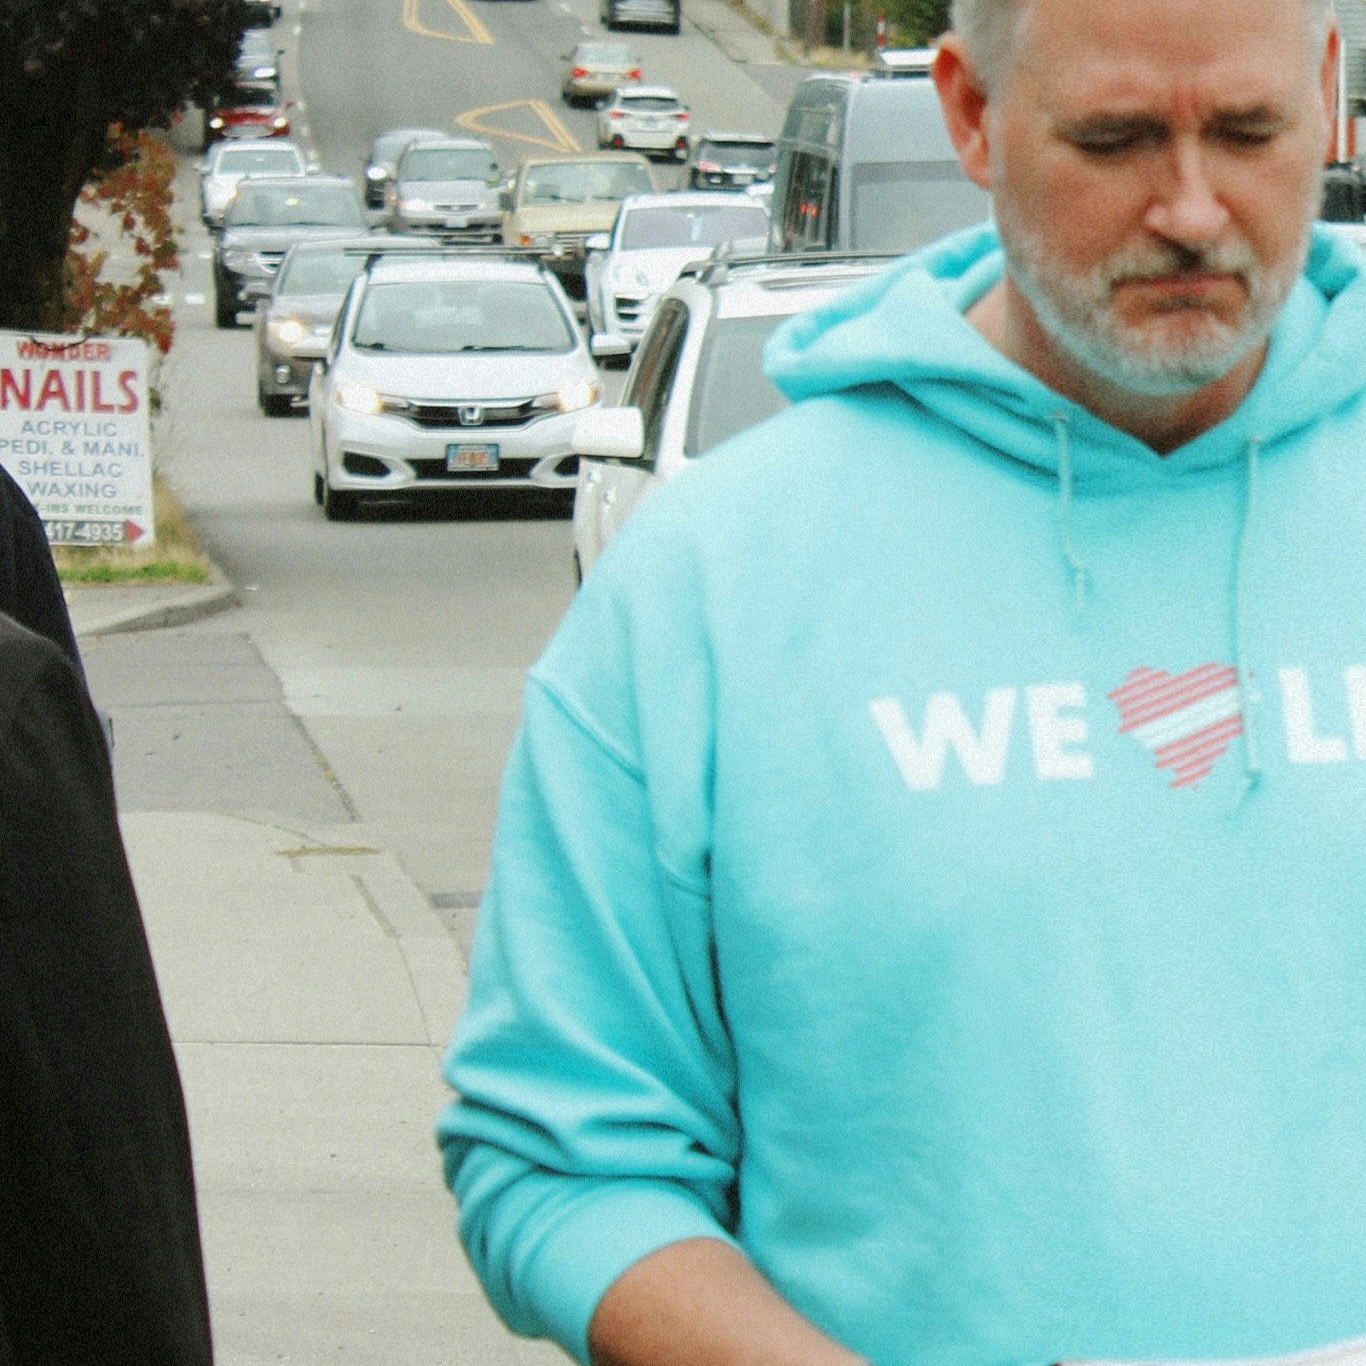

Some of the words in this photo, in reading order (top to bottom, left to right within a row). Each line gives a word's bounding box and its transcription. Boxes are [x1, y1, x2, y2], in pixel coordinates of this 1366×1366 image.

[0, 368, 139, 413] NAILS
[21, 420, 118, 438] ACRYLIC
[61, 440, 75, 455] &
[18, 460, 122, 478] SHELLAC
[27, 482, 118, 499] WAXING
[74, 504, 143, 515] WELCOME
[867, 681, 1096, 791] WE
